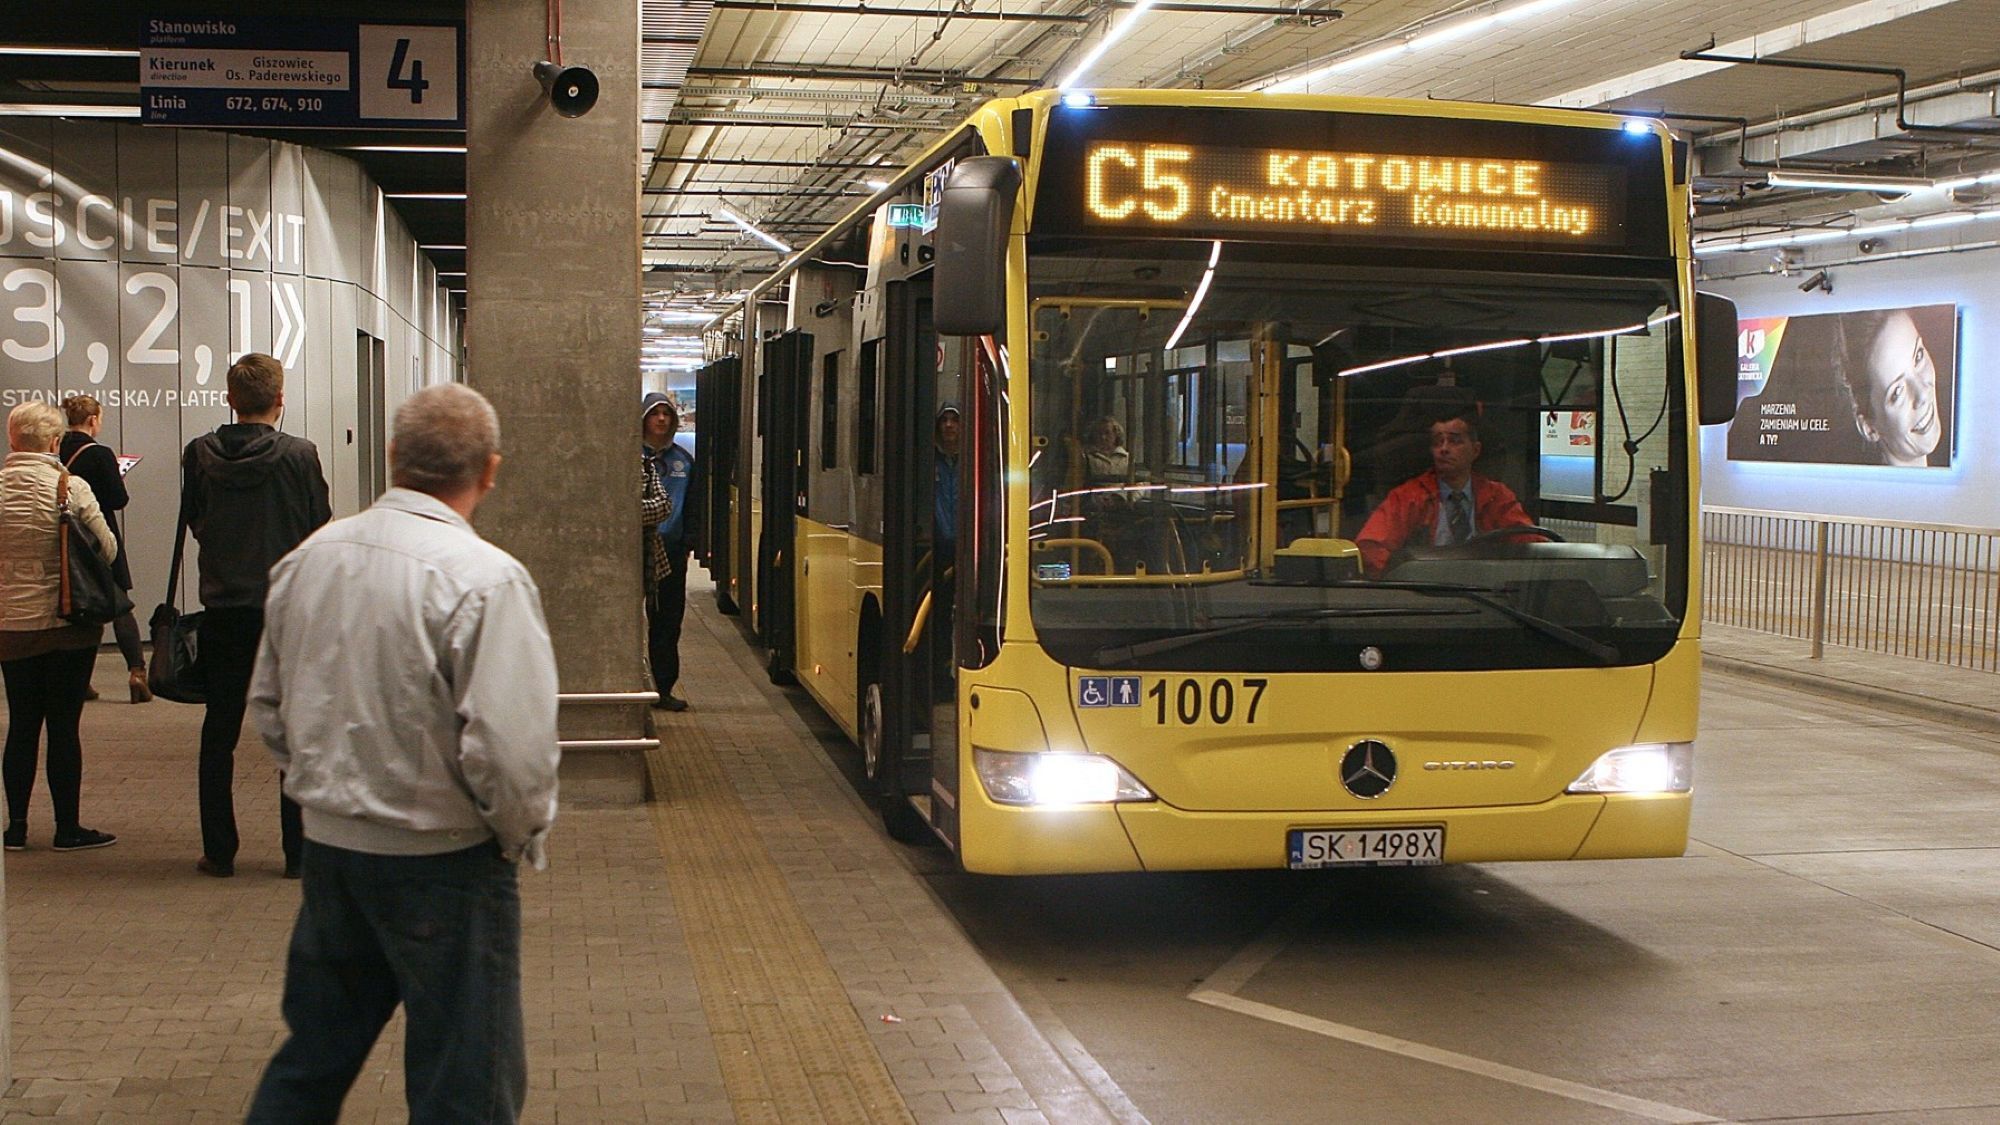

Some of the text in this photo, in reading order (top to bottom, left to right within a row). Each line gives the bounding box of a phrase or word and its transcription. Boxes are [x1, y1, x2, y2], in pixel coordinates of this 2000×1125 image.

[150, 20, 236, 35] Stanowisko
[149, 57, 215, 71] Kierunek
[252, 56, 314, 69] Giszowiec
[150, 72, 187, 81] direction
[225, 69, 342, 85] Os. Paderewskiego
[386, 38, 429, 104] 4
[150, 95, 187, 109] Linia
[226, 97, 322, 113] 672, 674, 910
[150, 111, 167, 120] line
[1268, 153, 1541, 196] KATOWICE
[1088, 147, 1191, 220] C5
[1210, 185, 1590, 235] Cmentarz Komunalny
[1760, 403, 1796, 415] MARZENIA
[1760, 418, 1830, 431] ZAMIENIAM W CELE.
[1759, 434, 1779, 446] A TY?
[1148, 678, 1268, 725] 1007
[1308, 831, 1437, 861] SK 1498X
